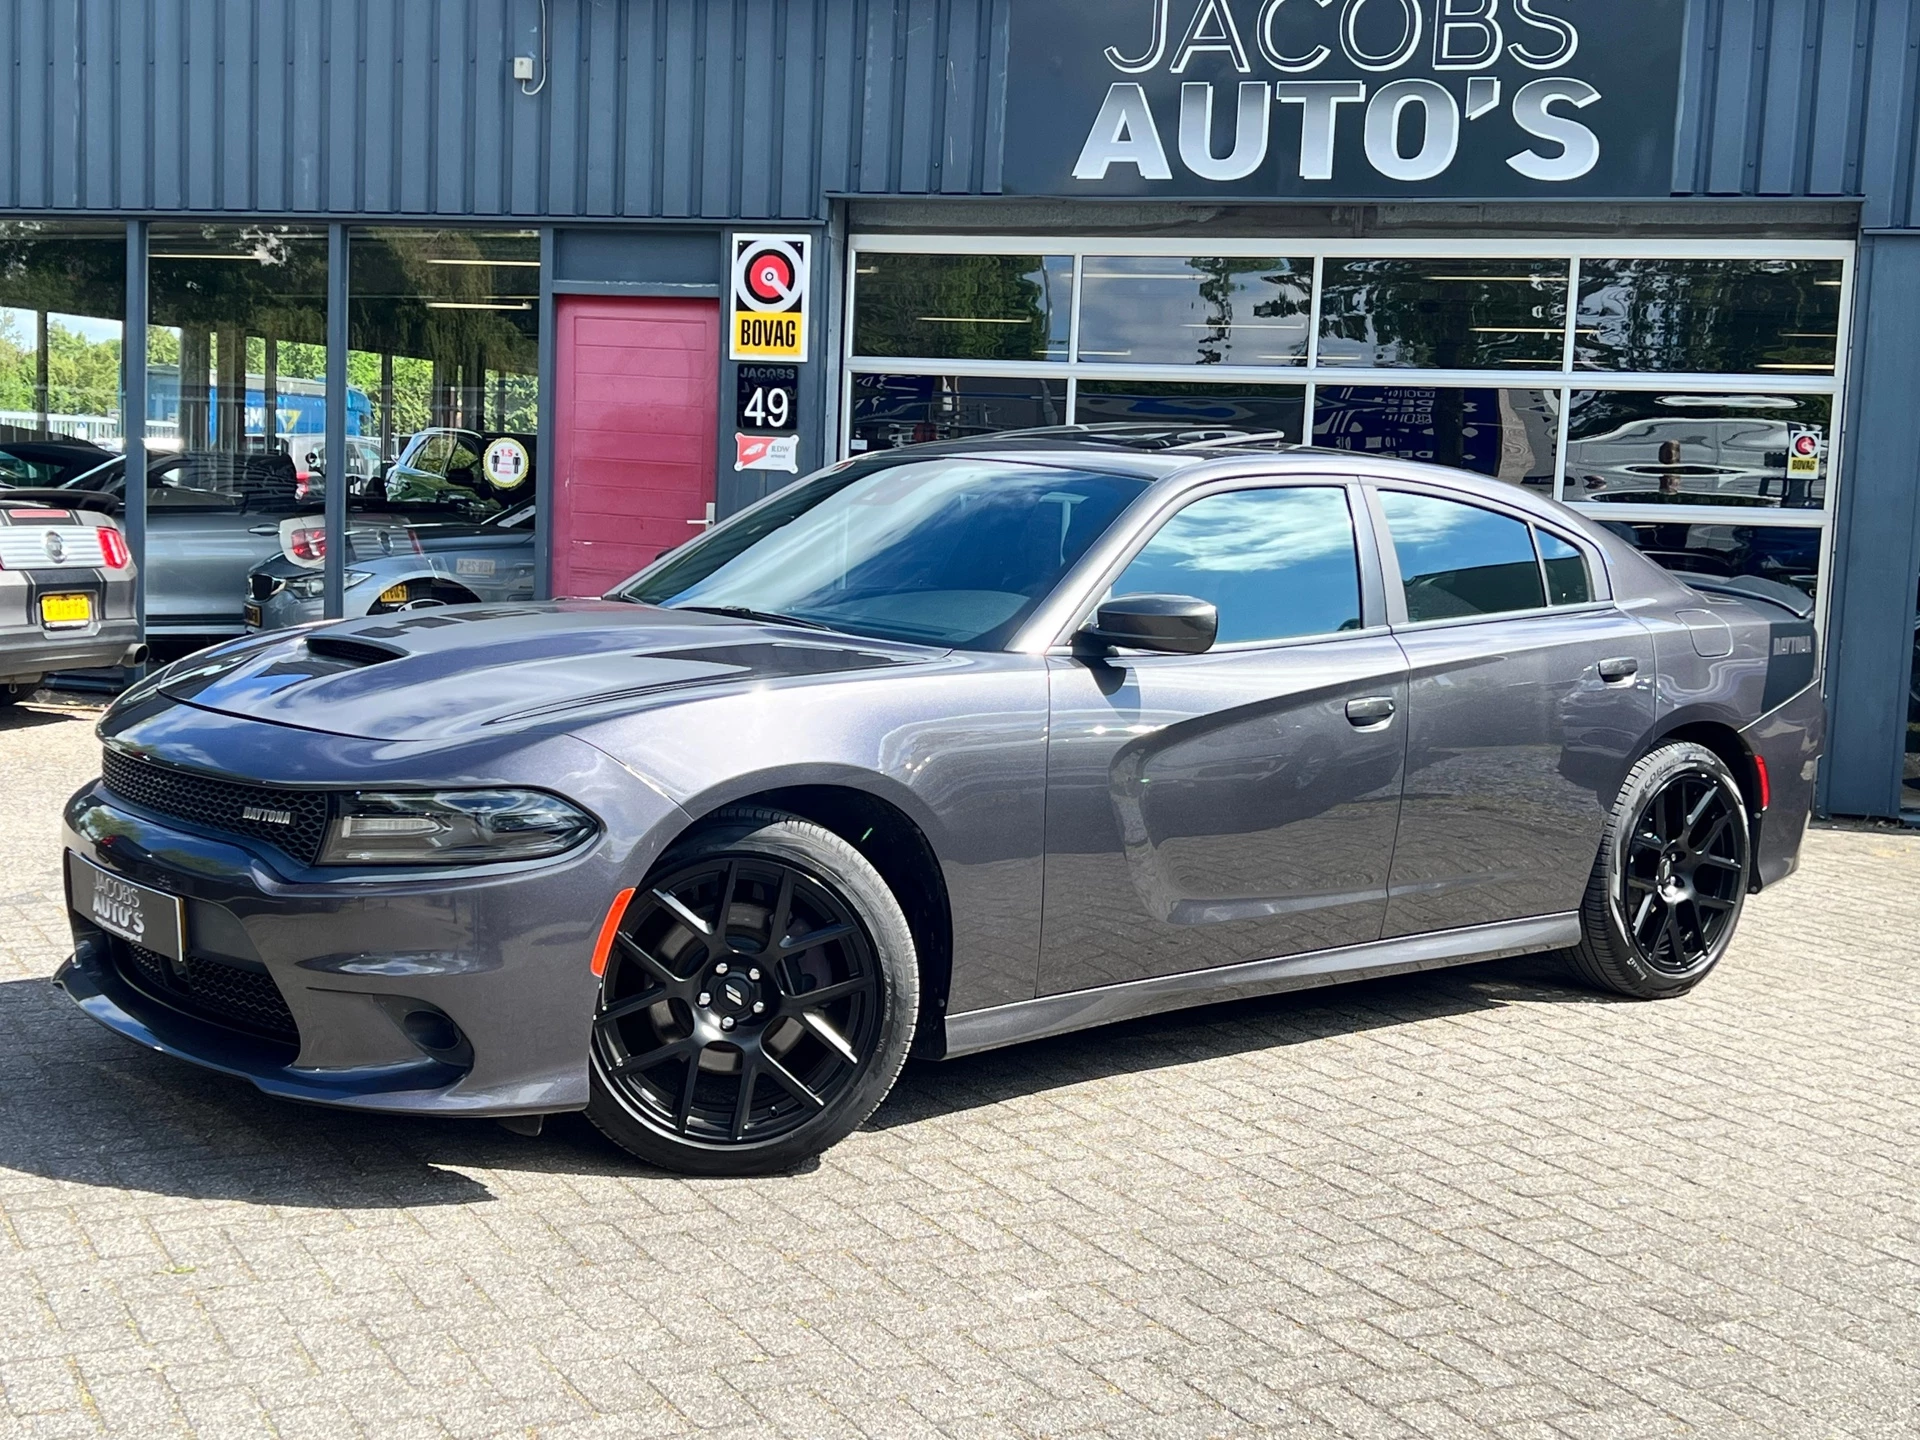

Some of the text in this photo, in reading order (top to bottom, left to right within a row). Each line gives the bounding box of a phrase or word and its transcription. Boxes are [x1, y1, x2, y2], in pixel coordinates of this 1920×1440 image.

[1104, 0, 1579, 73] JACOBS
[1071, 76, 1602, 182] AUTO'S
[740, 319, 796, 348] BOVAG
[740, 367, 795, 379] JACOBS
[744, 387, 788, 428] 49
[1792, 459, 1816, 471] BOVAG
[242, 806, 291, 825] DAYTONA
[93, 870, 141, 908] JACOBS
[92, 892, 145, 934] AUTO'S
